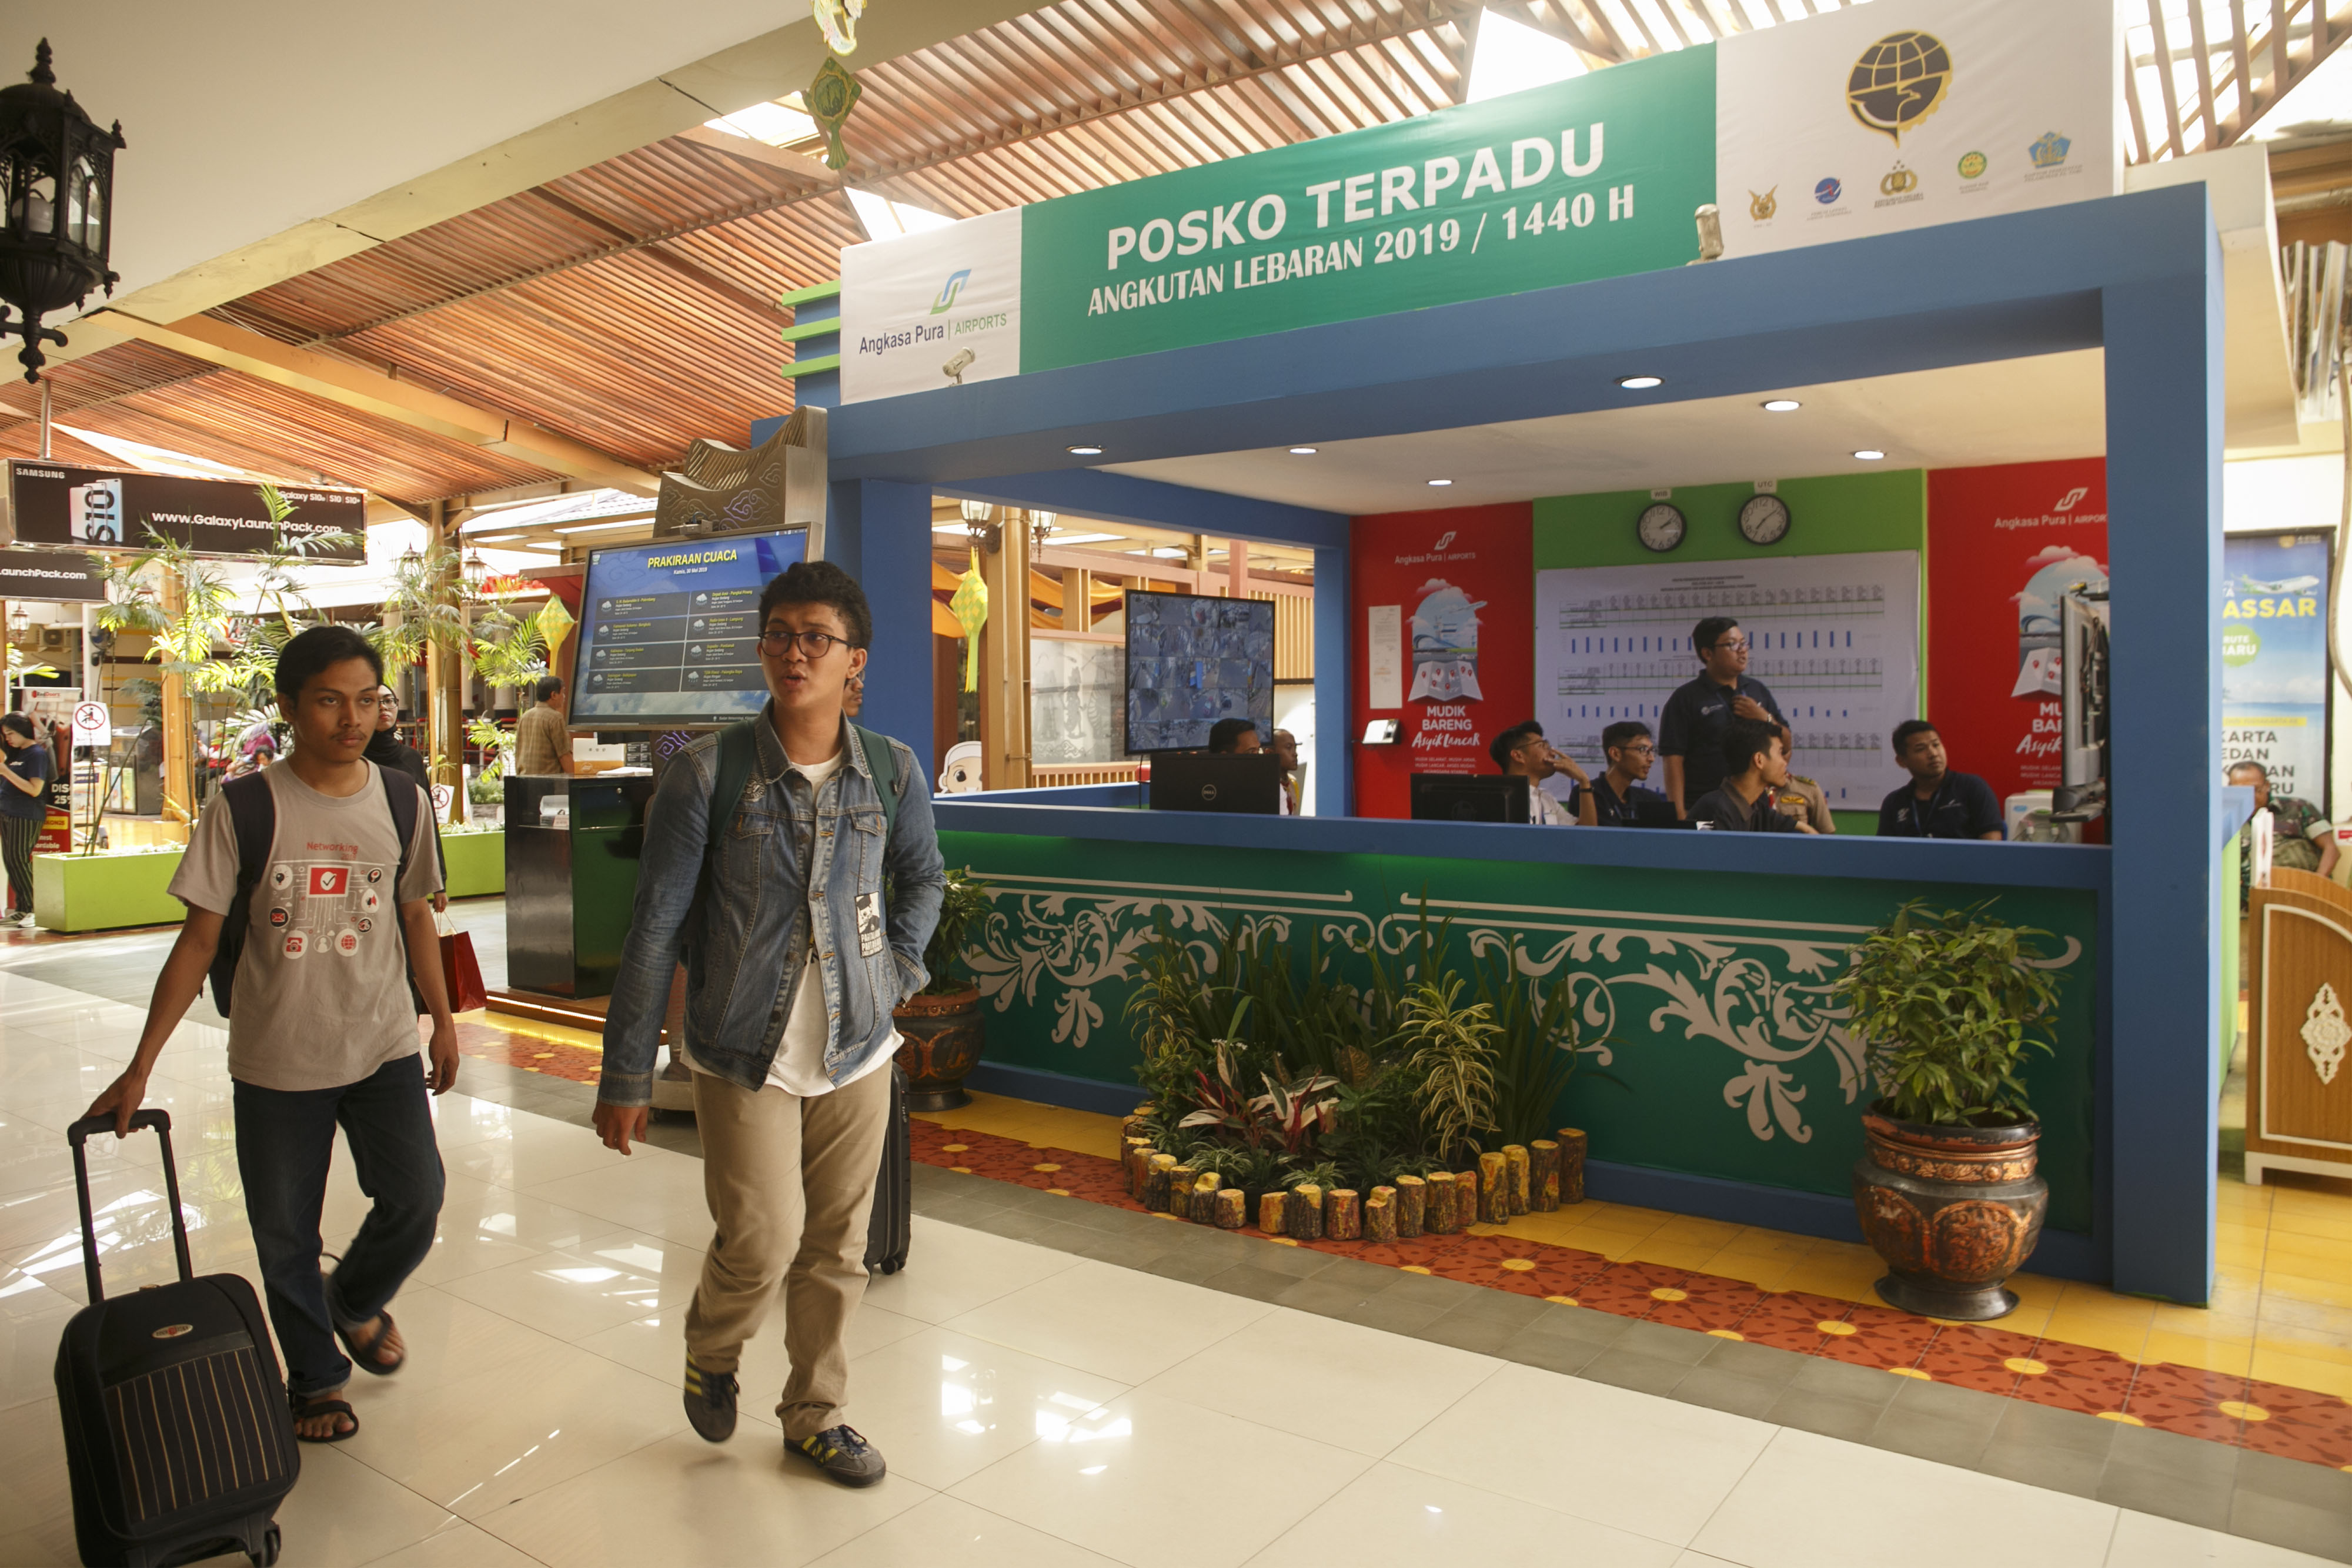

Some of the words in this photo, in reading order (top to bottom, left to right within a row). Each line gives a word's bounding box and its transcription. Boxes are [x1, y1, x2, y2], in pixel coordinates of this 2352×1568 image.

[1108, 195, 1287, 270] POSKO
[1306, 122, 1604, 229] TERPADU
[1088, 263, 1224, 316] ANGKUTAN
[1234, 236, 1363, 289] LEBARAN
[1374, 218, 1461, 265] 2019
[1502, 192, 1595, 240] 1440
[1609, 184, 1634, 222] H
[859, 332, 911, 355] Angkasa
[915, 325, 944, 343] Pura
[954, 312, 1007, 336] AIRPORTS
[16, 467, 65, 479] SAMSUNG
[278, 490, 308, 502] Galaxy
[329, 494, 342, 503] S10
[151, 511, 342, 533] www.GalaxyLaunchPack.com
[1994, 517, 2039, 530] Angkasa
[2042, 514, 2066, 526] Pura
[2074, 513, 2108, 523] AIRPOR
[647, 553, 701, 568] PRAKIRAAN
[703, 549, 737, 563] CUACA
[1395, 555, 1425, 566] Angkasa
[1426, 553, 1442, 562] Pura
[0, 567, 87, 580] aunchPack.com
[1426, 706, 1466, 717] MUDIK
[1422, 718, 1472, 730] BARENG
[306, 841, 358, 855] Networking
